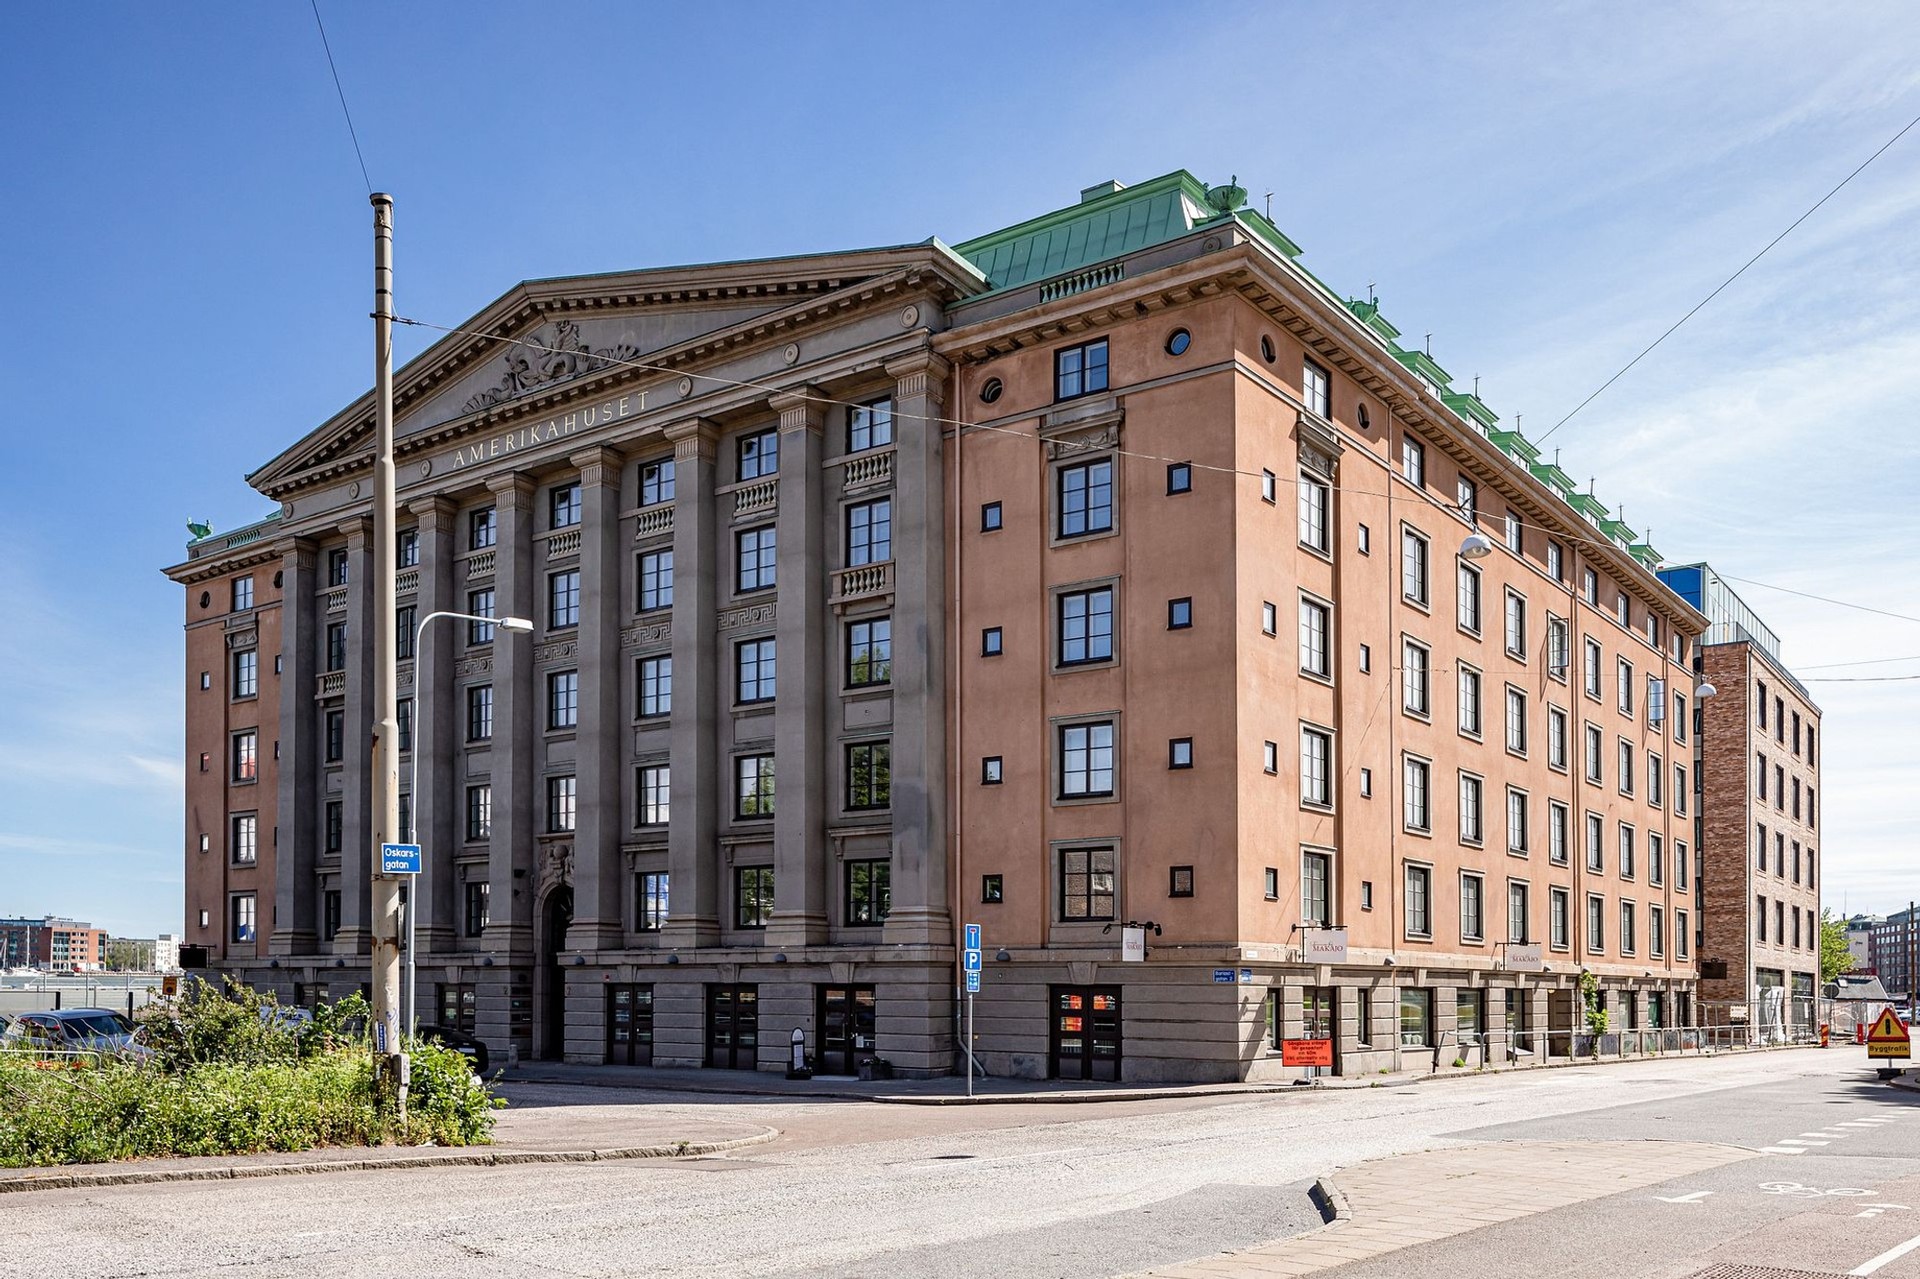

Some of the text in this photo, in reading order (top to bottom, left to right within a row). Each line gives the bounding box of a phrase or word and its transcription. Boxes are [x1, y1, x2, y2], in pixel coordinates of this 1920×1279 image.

[452, 390, 650, 469] AMERIKAHUSET
[385, 847, 418, 858] Oskars-
[385, 860, 409, 870] gatan
[969, 952, 978, 968] P
[1870, 1045, 1908, 1053] Byggtrafik
